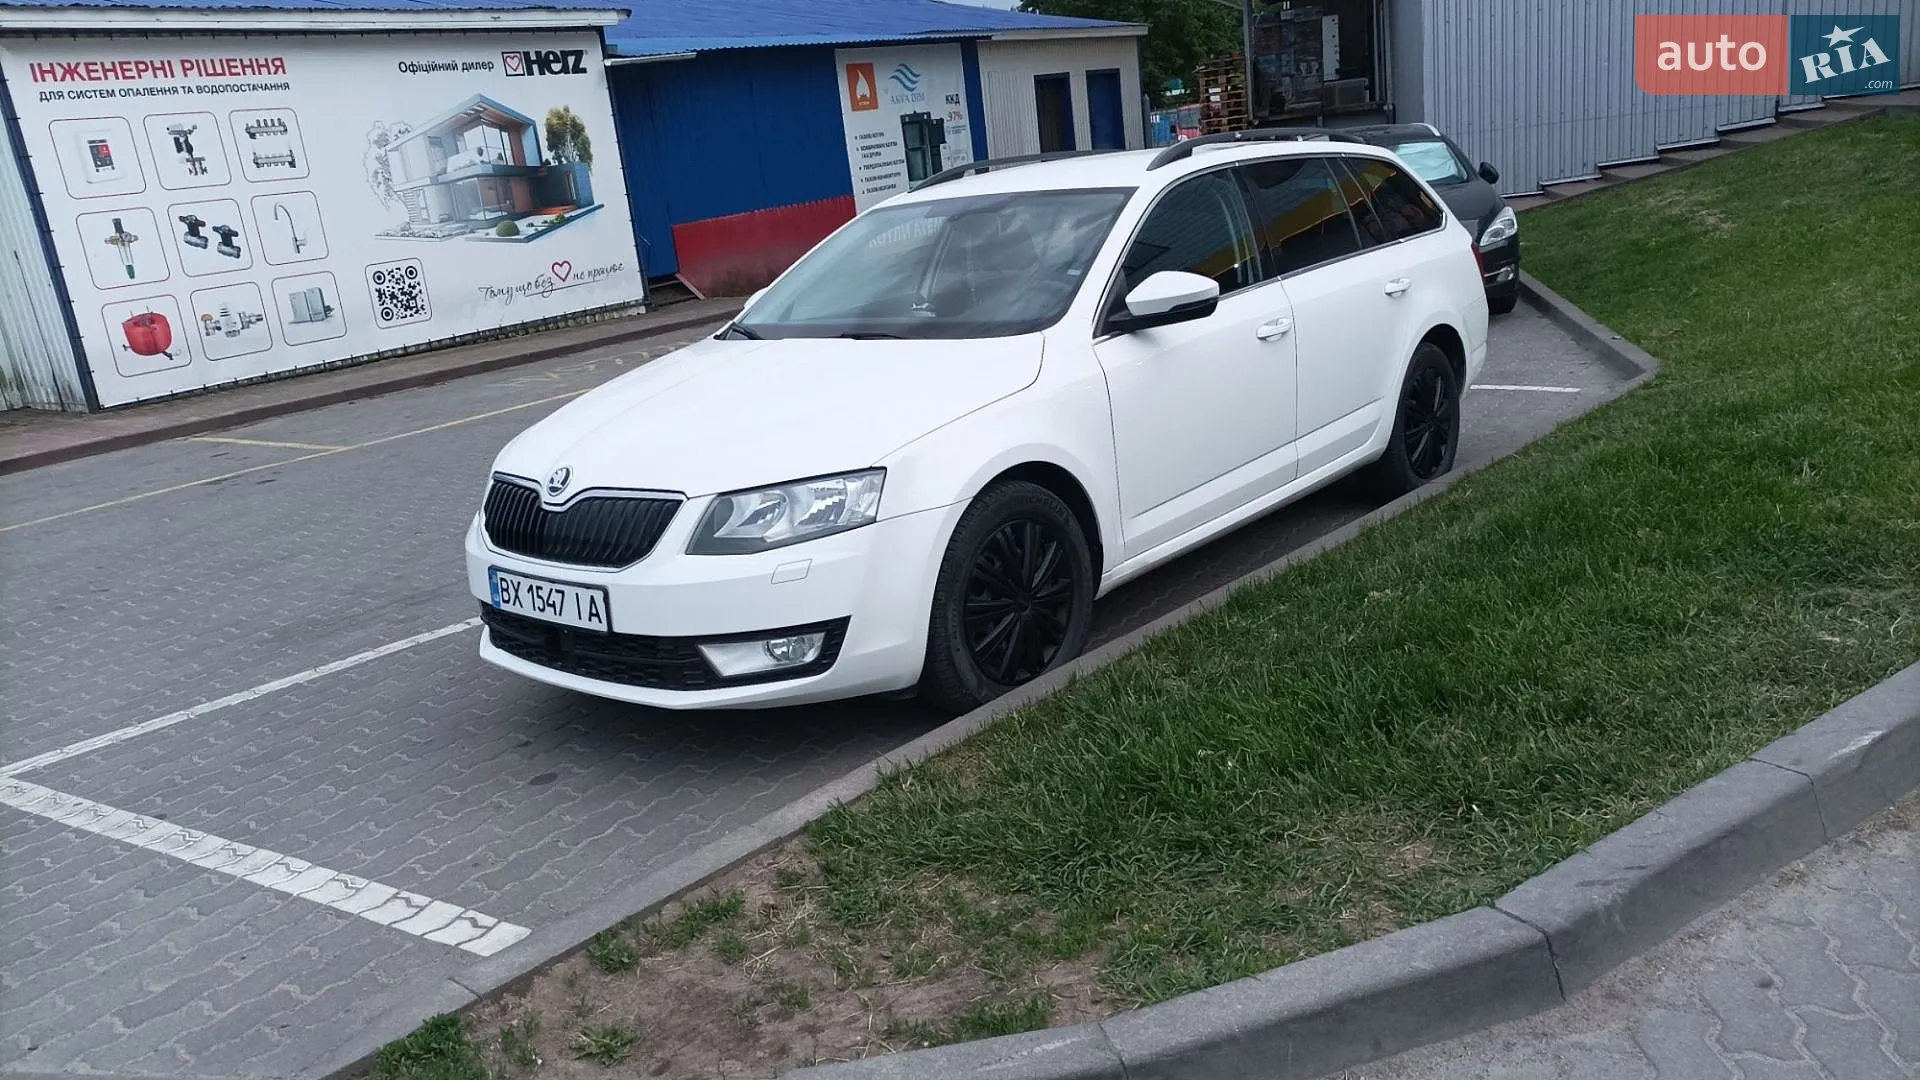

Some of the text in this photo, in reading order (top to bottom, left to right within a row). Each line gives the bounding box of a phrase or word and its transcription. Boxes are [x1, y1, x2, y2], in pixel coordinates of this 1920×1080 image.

[29, 56, 287, 83] ІНЖЕНЕРНІ РІШЕННЯ
[398, 59, 495, 76] Офіційний дилер
[39, 81, 291, 103] ДЛЯ СИСТЕМ ОПАЛЕННЯ ТА ВОДОПОСТАЧАННЯ
[945, 93, 961, 106] ККД
[499, 577, 603, 624] BX 1547 IA
